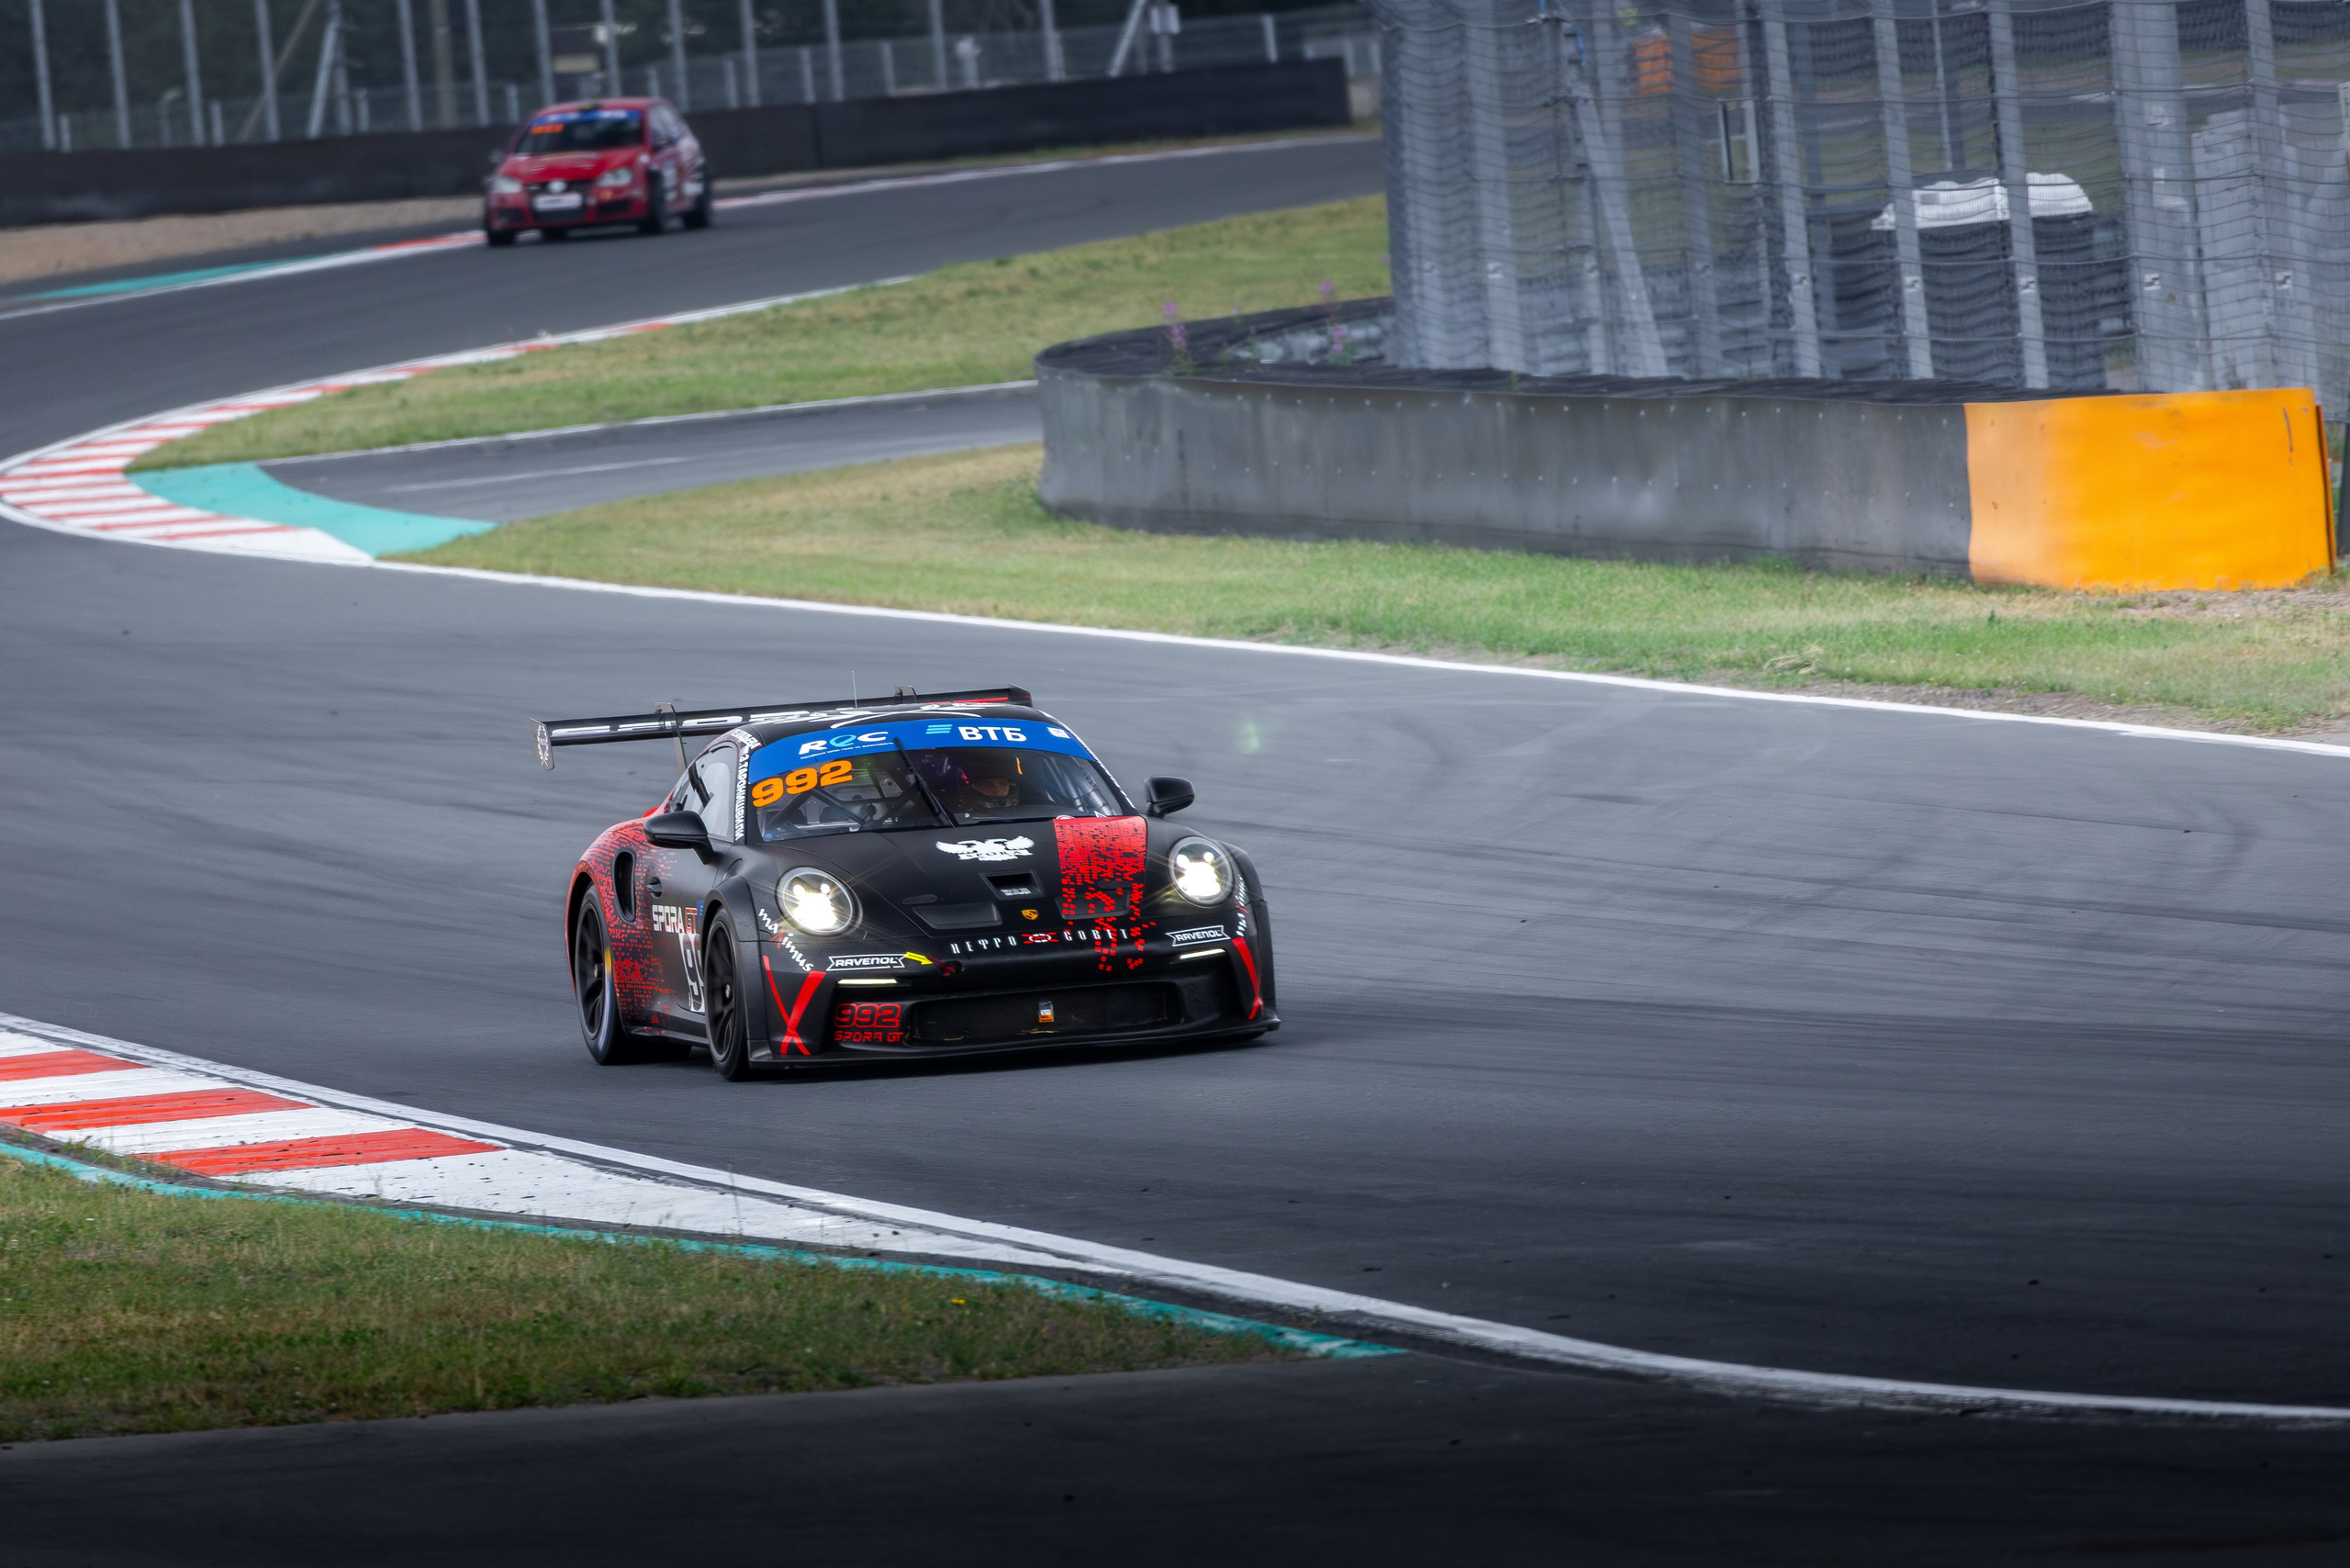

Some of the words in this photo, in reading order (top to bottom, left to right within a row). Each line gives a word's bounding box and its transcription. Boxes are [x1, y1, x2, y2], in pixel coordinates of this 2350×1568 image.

[957, 726, 1027, 742] ВТБ
[751, 759, 854, 808] 992
[652, 904, 685, 934] SPORA
[685, 907, 698, 934] GT
[1176, 929, 1224, 942] RAVENOL
[834, 957, 899, 968] RAVENOL
[834, 1002, 901, 1028] 992
[834, 1030, 883, 1042] SPORA
[886, 1031, 904, 1043] GT
